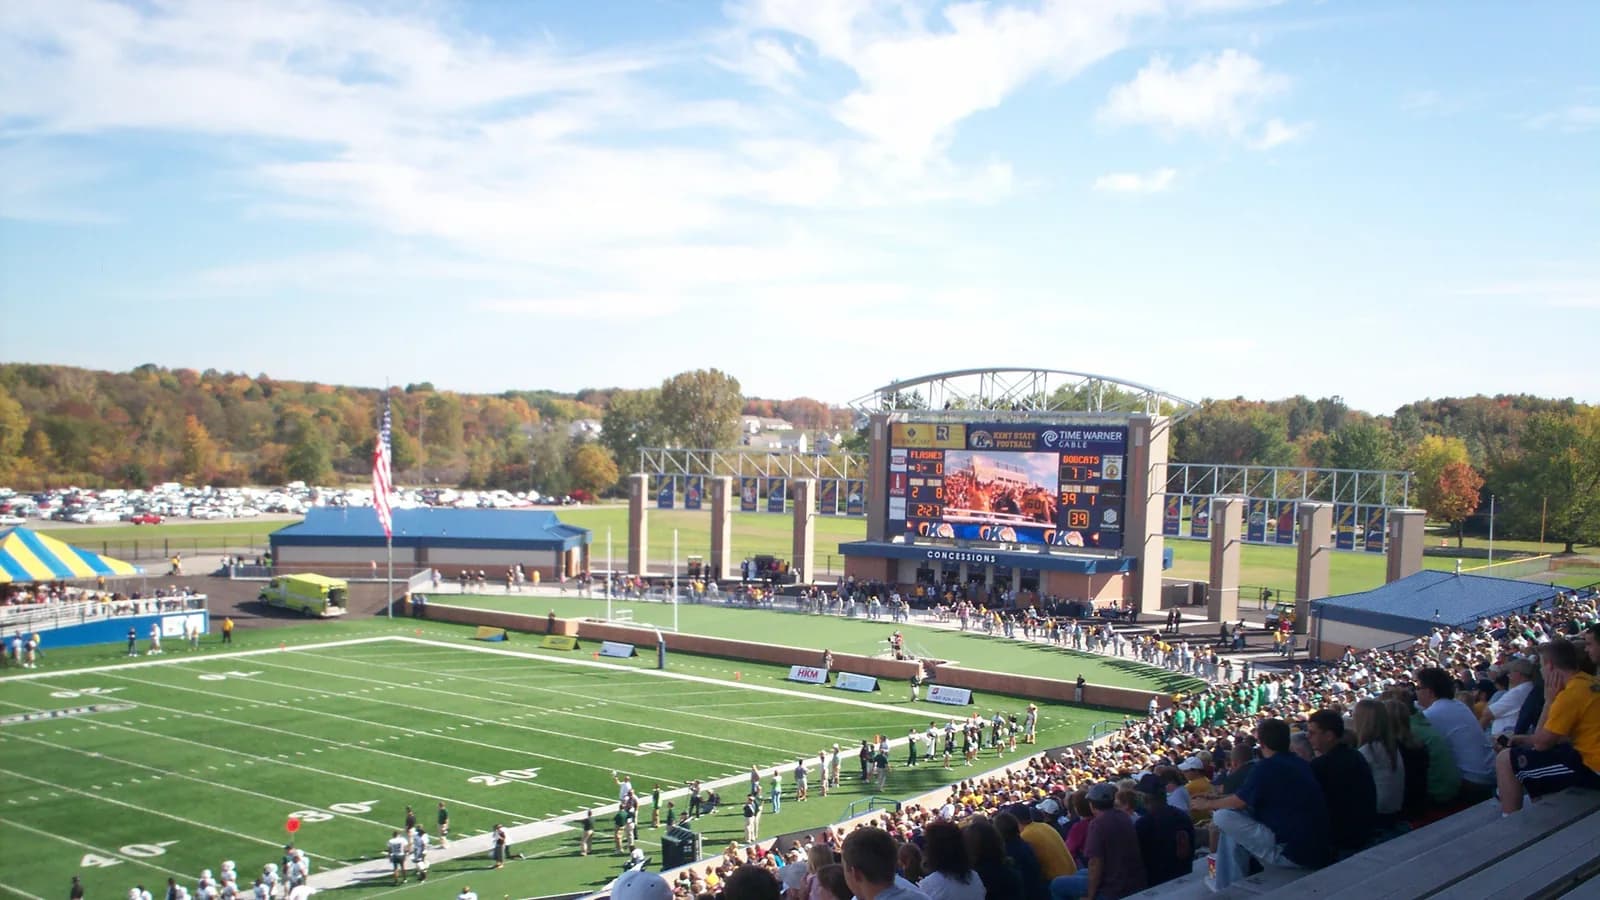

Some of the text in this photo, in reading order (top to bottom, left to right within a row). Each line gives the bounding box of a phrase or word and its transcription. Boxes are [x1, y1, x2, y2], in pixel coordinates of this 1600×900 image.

[1059, 431, 1122, 441] TIME WARNER
[1059, 441, 1088, 449] CABLE
[910, 451, 943, 460] FLASHES
[1063, 455, 1100, 465] BOBCATS
[911, 487, 919, 498] 2
[935, 487, 943, 499] 8
[1062, 493, 1077, 505] 39
[917, 504, 940, 516] 2:27
[1071, 512, 1087, 525] 39
[927, 550, 997, 563] CONCESSIONS
[797, 668, 819, 679] HKM
[612, 741, 671, 756] 10
[467, 768, 537, 786] 20
[288, 801, 372, 822] 30
[80, 843, 167, 868] 40
